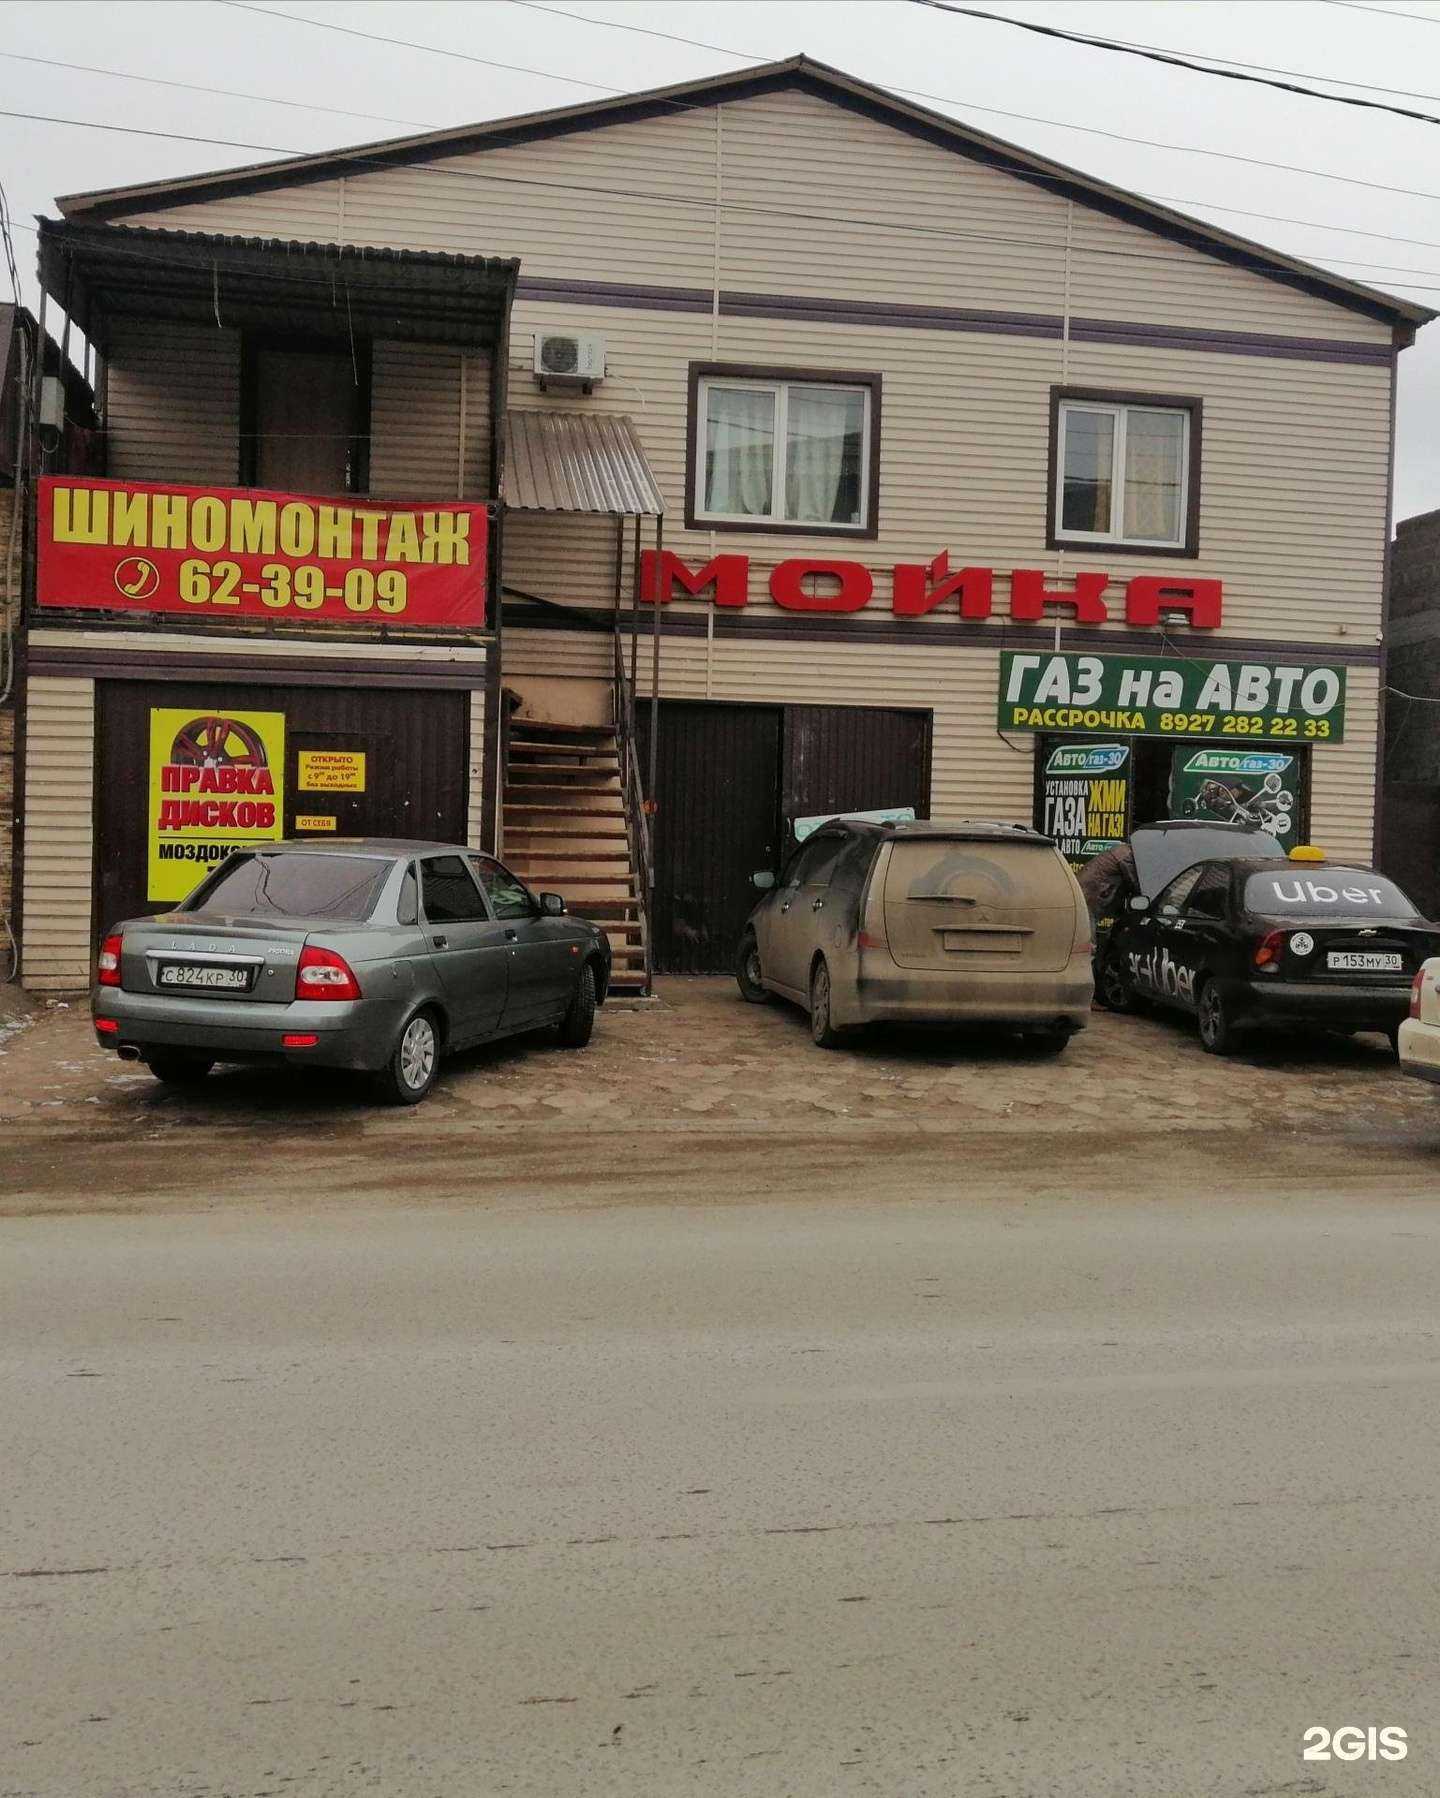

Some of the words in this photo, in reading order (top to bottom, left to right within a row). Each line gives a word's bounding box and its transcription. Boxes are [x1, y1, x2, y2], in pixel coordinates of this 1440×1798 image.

[53, 487, 471, 565] ШИНОМОНТАЖ
[178, 558, 408, 614] 62-39-09
[640, 549, 1223, 628] МОЙКА
[1005, 654, 1105, 706] ГАЗ
[1117, 669, 1185, 709] на
[1195, 663, 1340, 716] АВТО
[1013, 707, 1146, 730] РАССРОЧКА
[1160, 713, 1216, 732] 8927
[1222, 716, 1264, 735] 282
[1270, 717, 1298, 737] 22
[1303, 718, 1330, 738] 33
[311, 755, 353, 764] ОТКРЫТО
[160, 765, 275, 795] ПРАВКА
[1045, 780, 1089, 796] УСТАНОВКА
[1088, 780, 1127, 812] ЖМИ
[158, 799, 276, 830] ДИСКОВ
[1044, 797, 1087, 837] ГАЗА
[1088, 813, 1102, 837] НА
[1103, 813, 1125, 837] ГАЗ!
[159, 844, 246, 862] МОЗДОК
[1061, 838, 1081, 854] АВТО
[1272, 880, 1384, 905] Uber
[1385, 955, 1397, 965] 30
